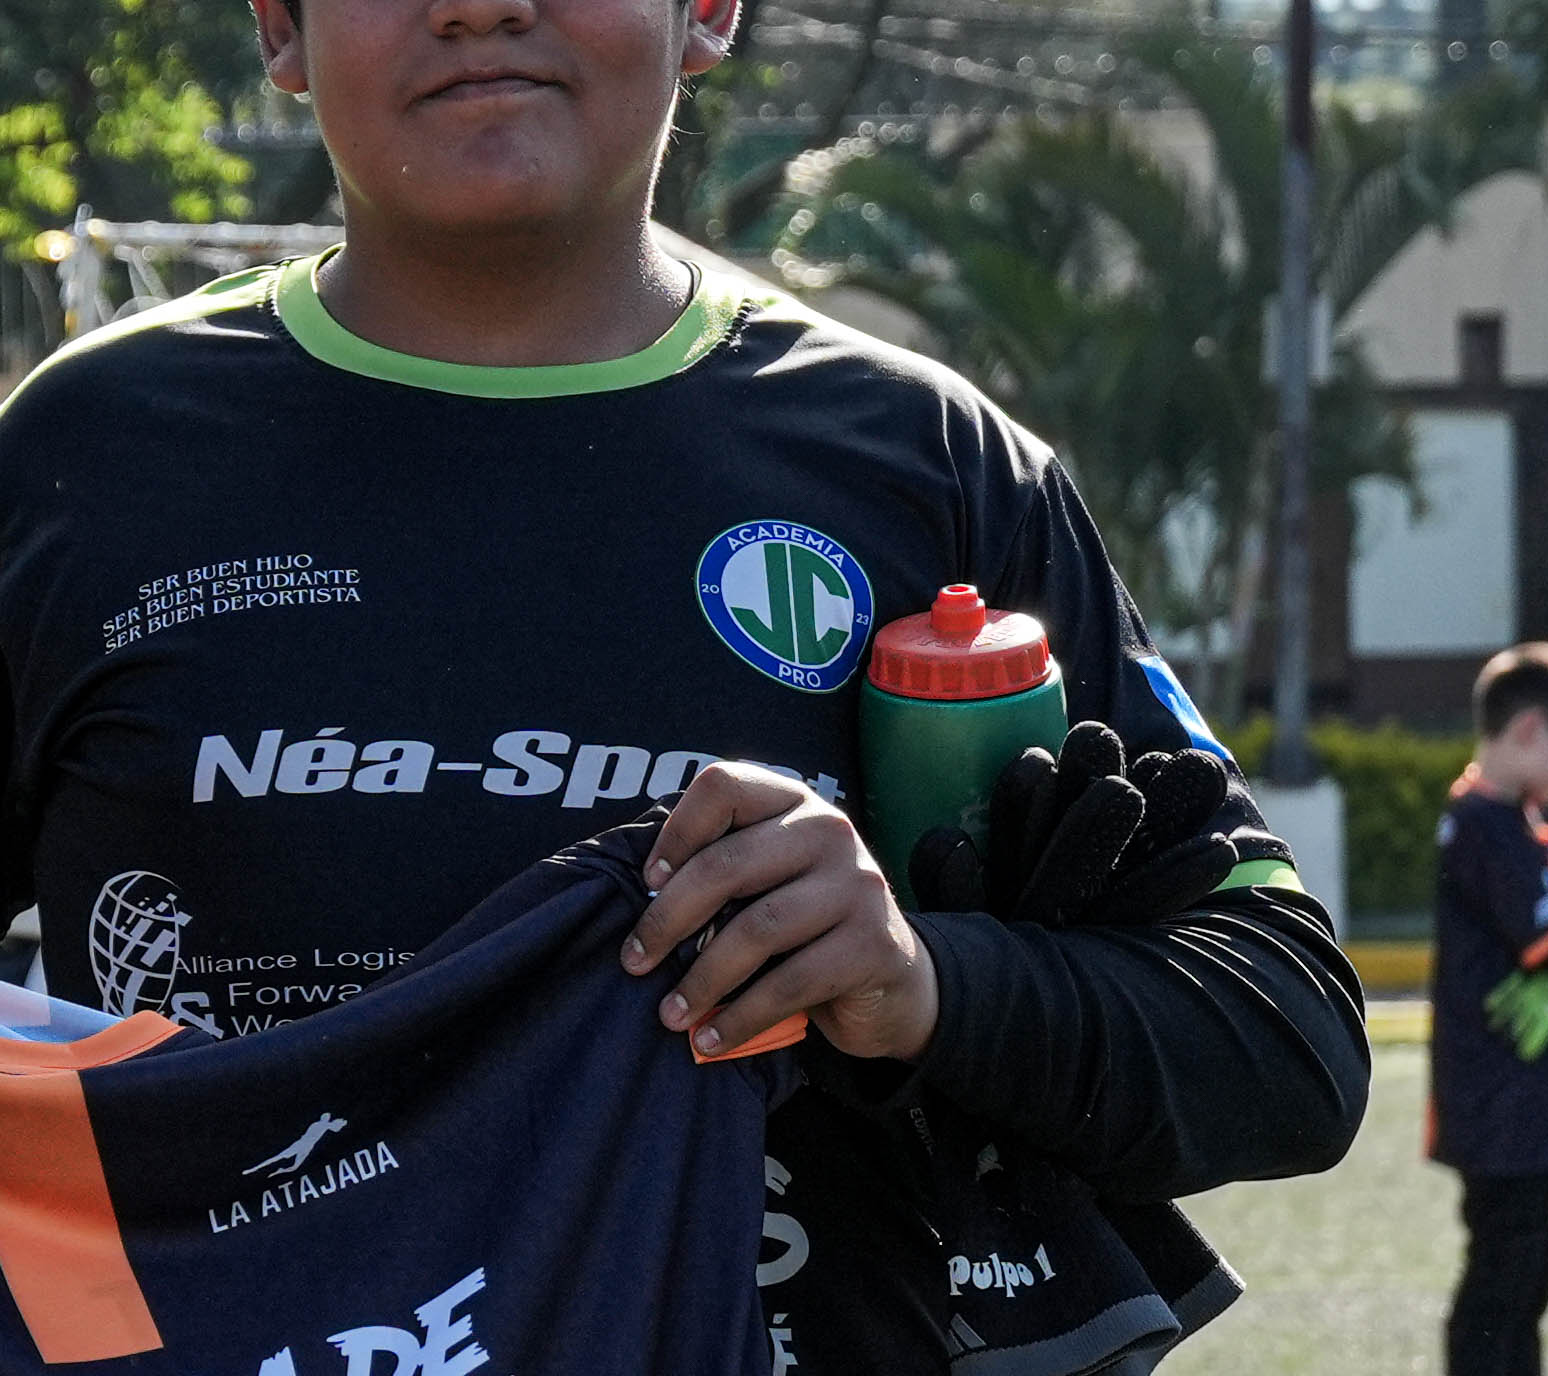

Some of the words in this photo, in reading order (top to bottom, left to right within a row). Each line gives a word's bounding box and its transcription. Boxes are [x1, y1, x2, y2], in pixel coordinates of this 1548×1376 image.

[727, 524, 845, 568] ACADEMIA
[138, 574, 181, 600] SER
[186, 559, 247, 585] BUEN
[256, 553, 313, 572] HIJO
[701, 584, 720, 594] 20
[103, 606, 141, 637] SER
[146, 585, 203, 616] BUEN
[212, 568, 361, 596] ESTUDIANTE
[105, 625, 142, 655] SER
[147, 602, 205, 634] BUEN
[213, 586, 361, 614] DEPORTISTA
[855, 612, 870, 626] 23
[778, 663, 822, 688] PRO
[175, 954, 297, 975] Alliance
[208, 1200, 251, 1234] LA
[261, 1140, 400, 1218] ATAJADA
[947, 1252, 1035, 1298] Pulpo
